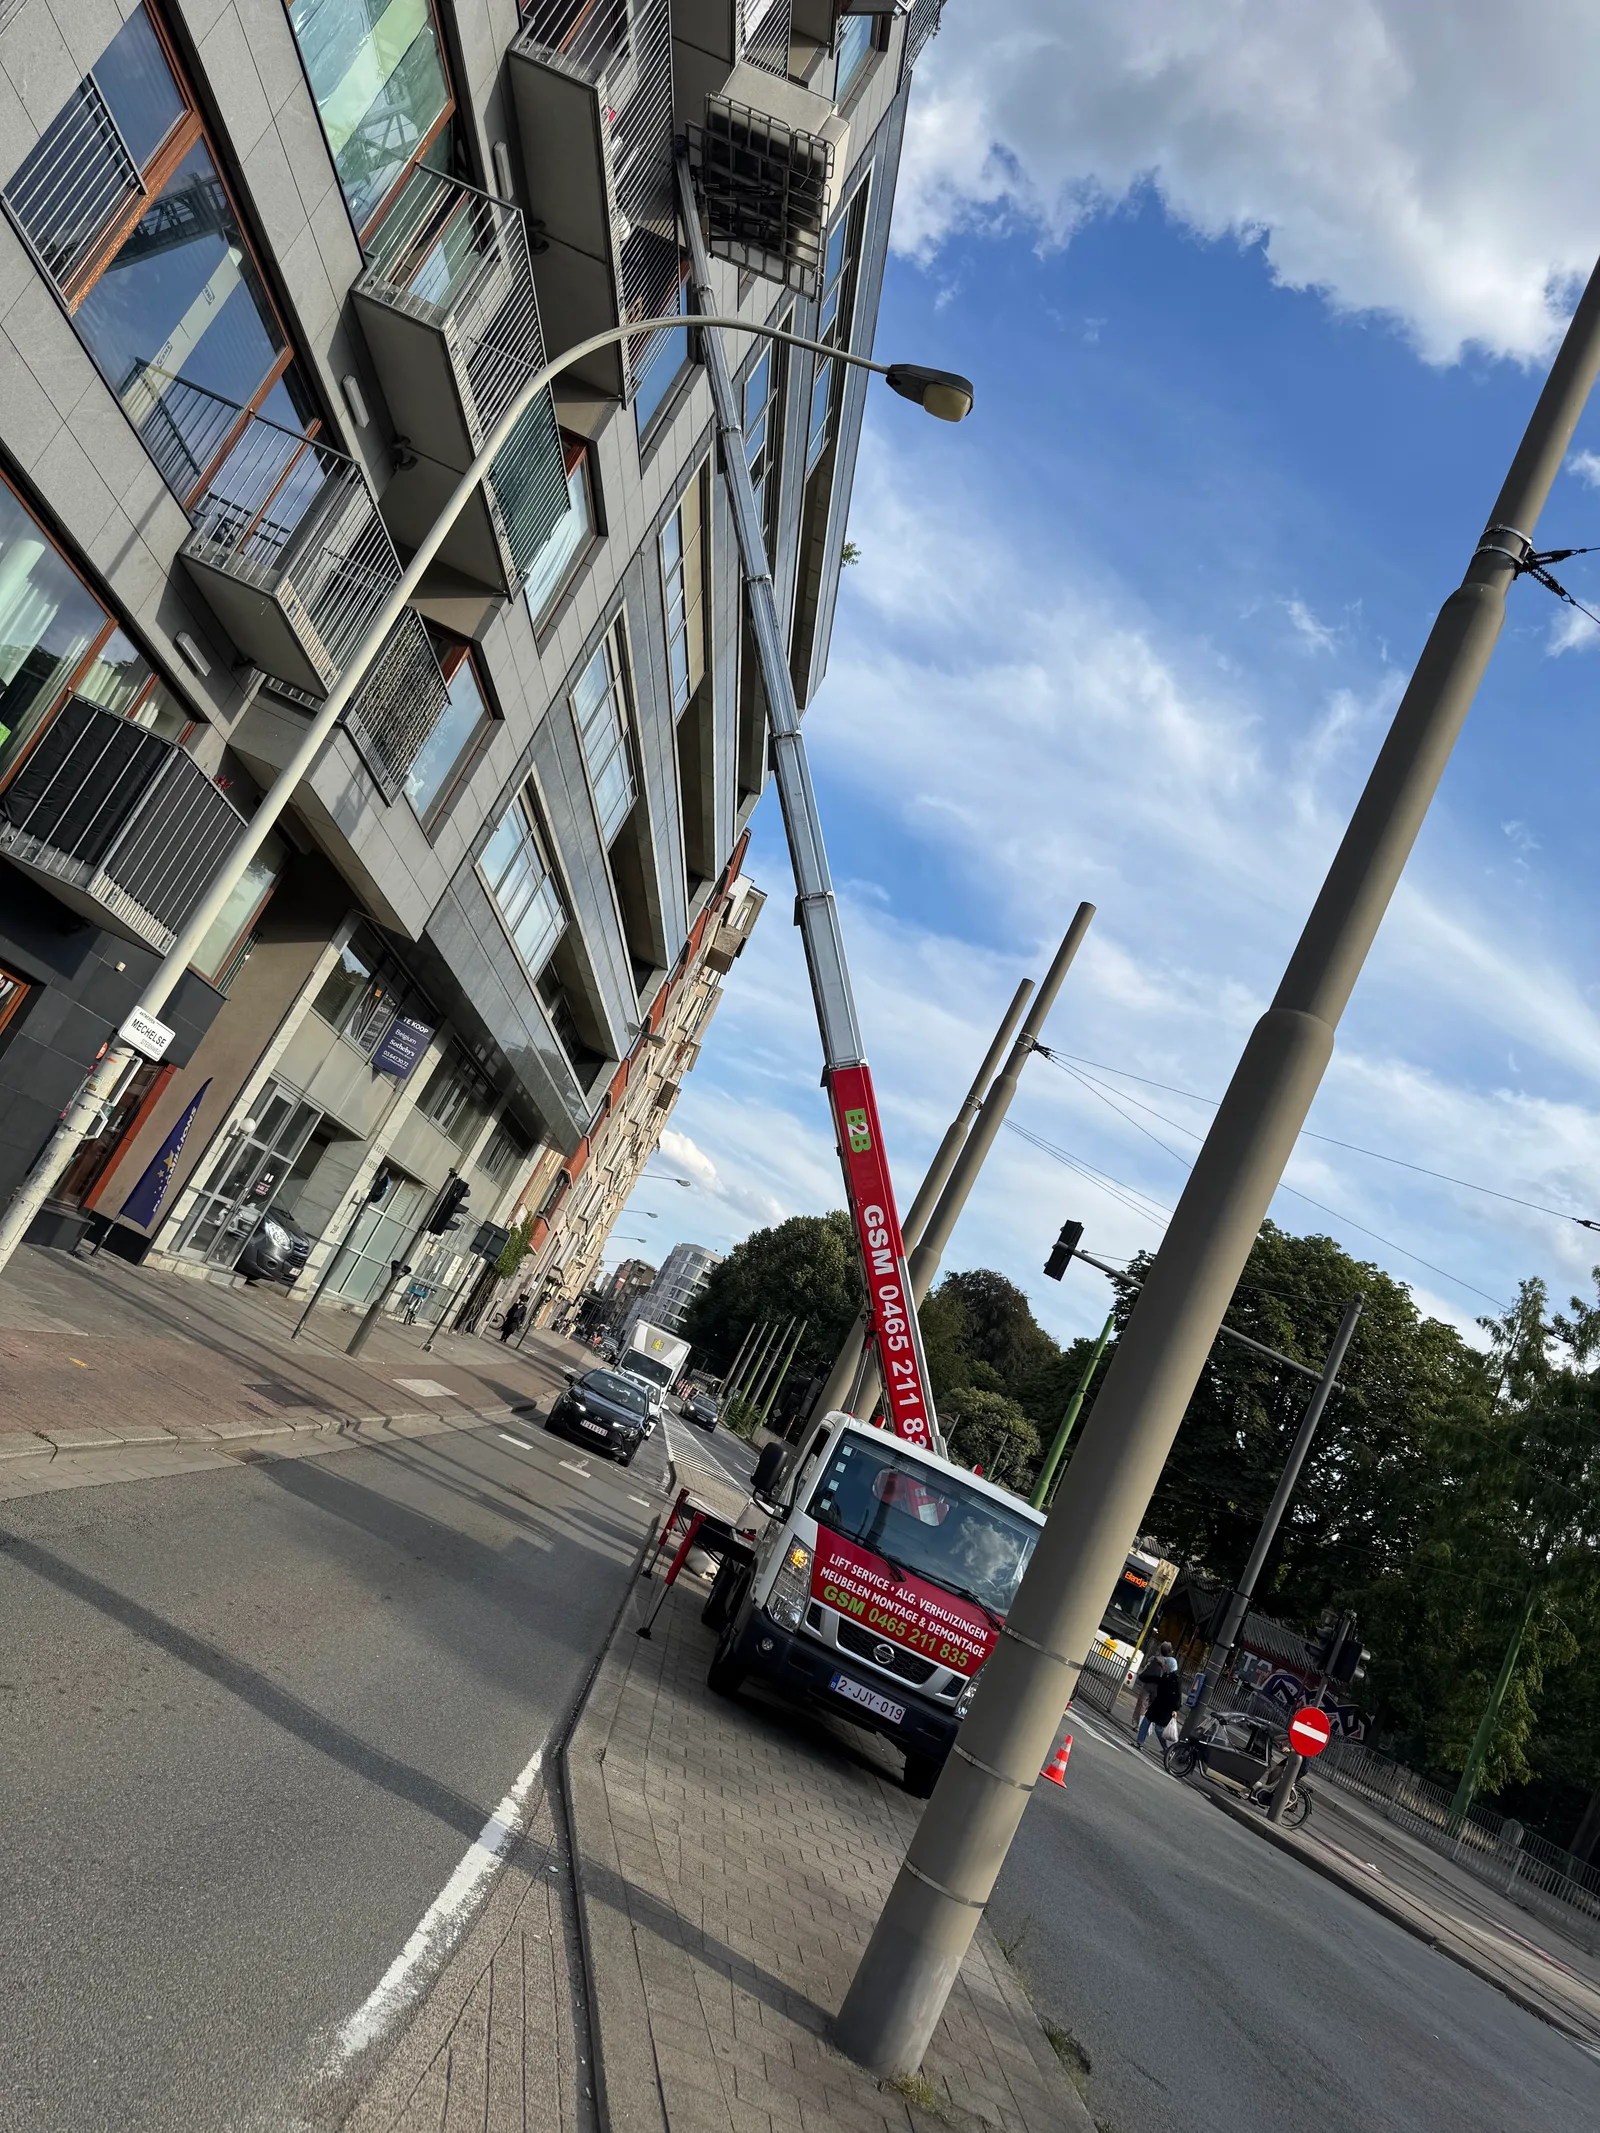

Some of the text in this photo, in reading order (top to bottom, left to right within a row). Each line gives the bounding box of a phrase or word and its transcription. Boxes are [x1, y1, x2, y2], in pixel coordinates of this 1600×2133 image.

[131, 1018, 167, 1048] MECHELSE
[389, 1039, 415, 1057] Sotheby's
[394, 1029, 417, 1045] Belgium
[411, 1021, 429, 1034] KOOP
[845, 1108, 871, 1153] B2B
[864, 1205, 895, 1275] GSM
[879, 1285, 909, 1351] 0465
[892, 1359, 920, 1406] 211
[820, 1567, 871, 1599] MEUBELEN
[871, 1593, 919, 1624] MONTAGE
[918, 1617, 926, 1628] &
[927, 1622, 985, 1658] DEMONTAGE
[829, 1553, 988, 1641] LIFT SERVICE ALG. VERHUIZINGEN
[823, 1585, 969, 1667] GSM 0465 211 835
